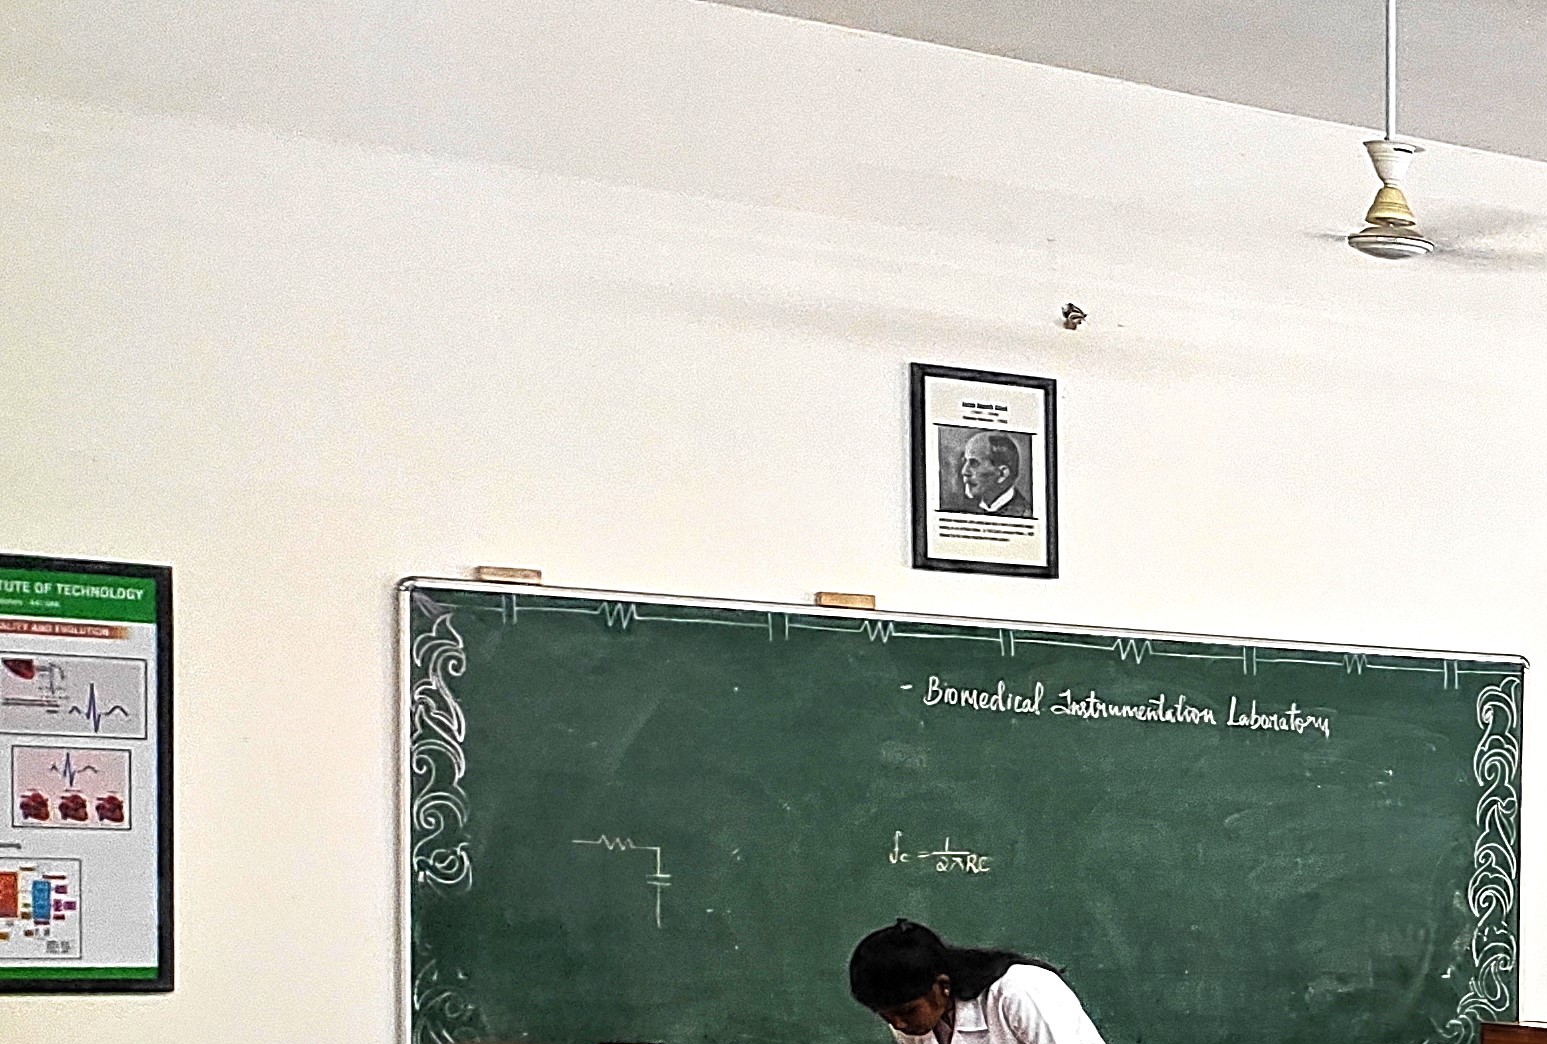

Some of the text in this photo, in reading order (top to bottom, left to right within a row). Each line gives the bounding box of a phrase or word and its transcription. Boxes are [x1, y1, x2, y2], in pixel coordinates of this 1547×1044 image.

[34, 582, 52, 594] OF
[57, 583, 144, 600] TECHNOLOGY
[924, 676, 1331, 738] Biomedical Instrumentation Laboratory
